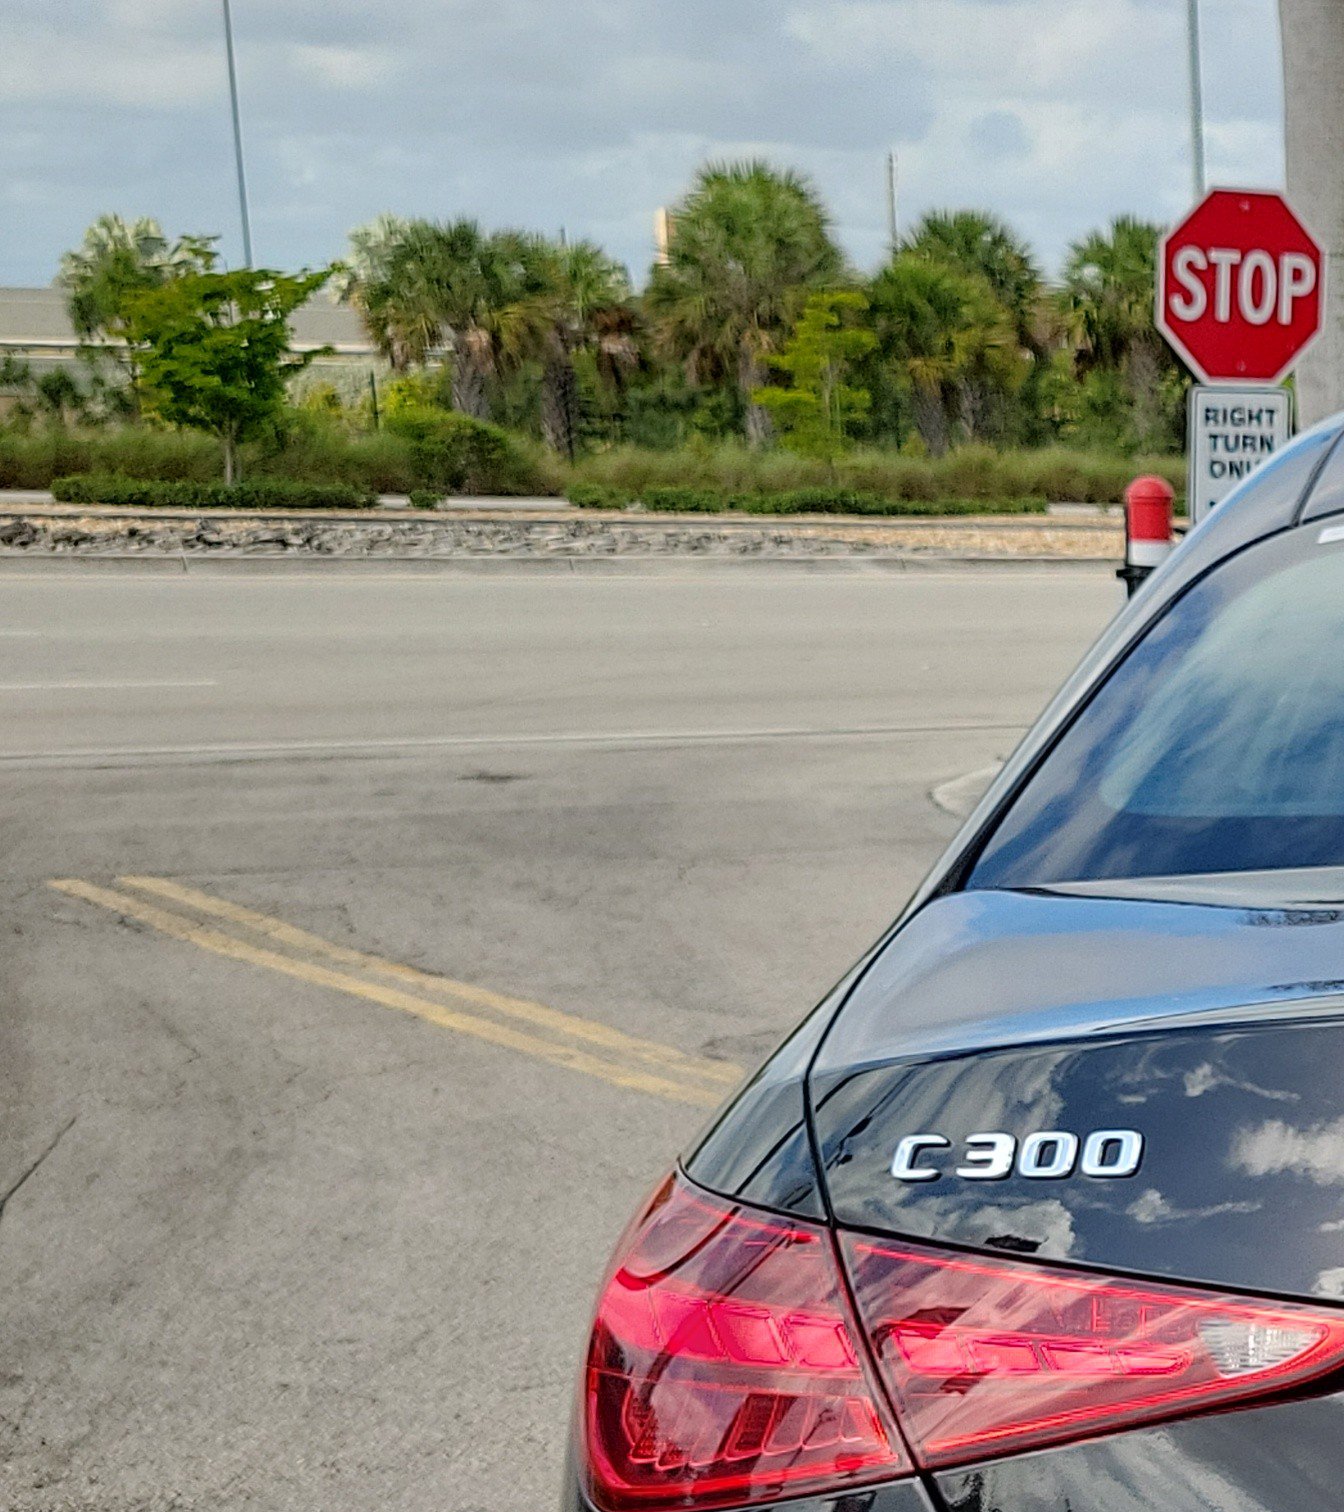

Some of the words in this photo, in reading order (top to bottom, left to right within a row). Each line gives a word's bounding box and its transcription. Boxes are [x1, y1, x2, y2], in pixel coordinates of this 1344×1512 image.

[1169, 245, 1317, 326] STOP
[1205, 406, 1276, 427] RIGHT
[1209, 433, 1274, 453] TURN
[1210, 460, 1261, 480] ON
[891, 1134, 949, 1180] C
[955, 1129, 1143, 1179] 300
